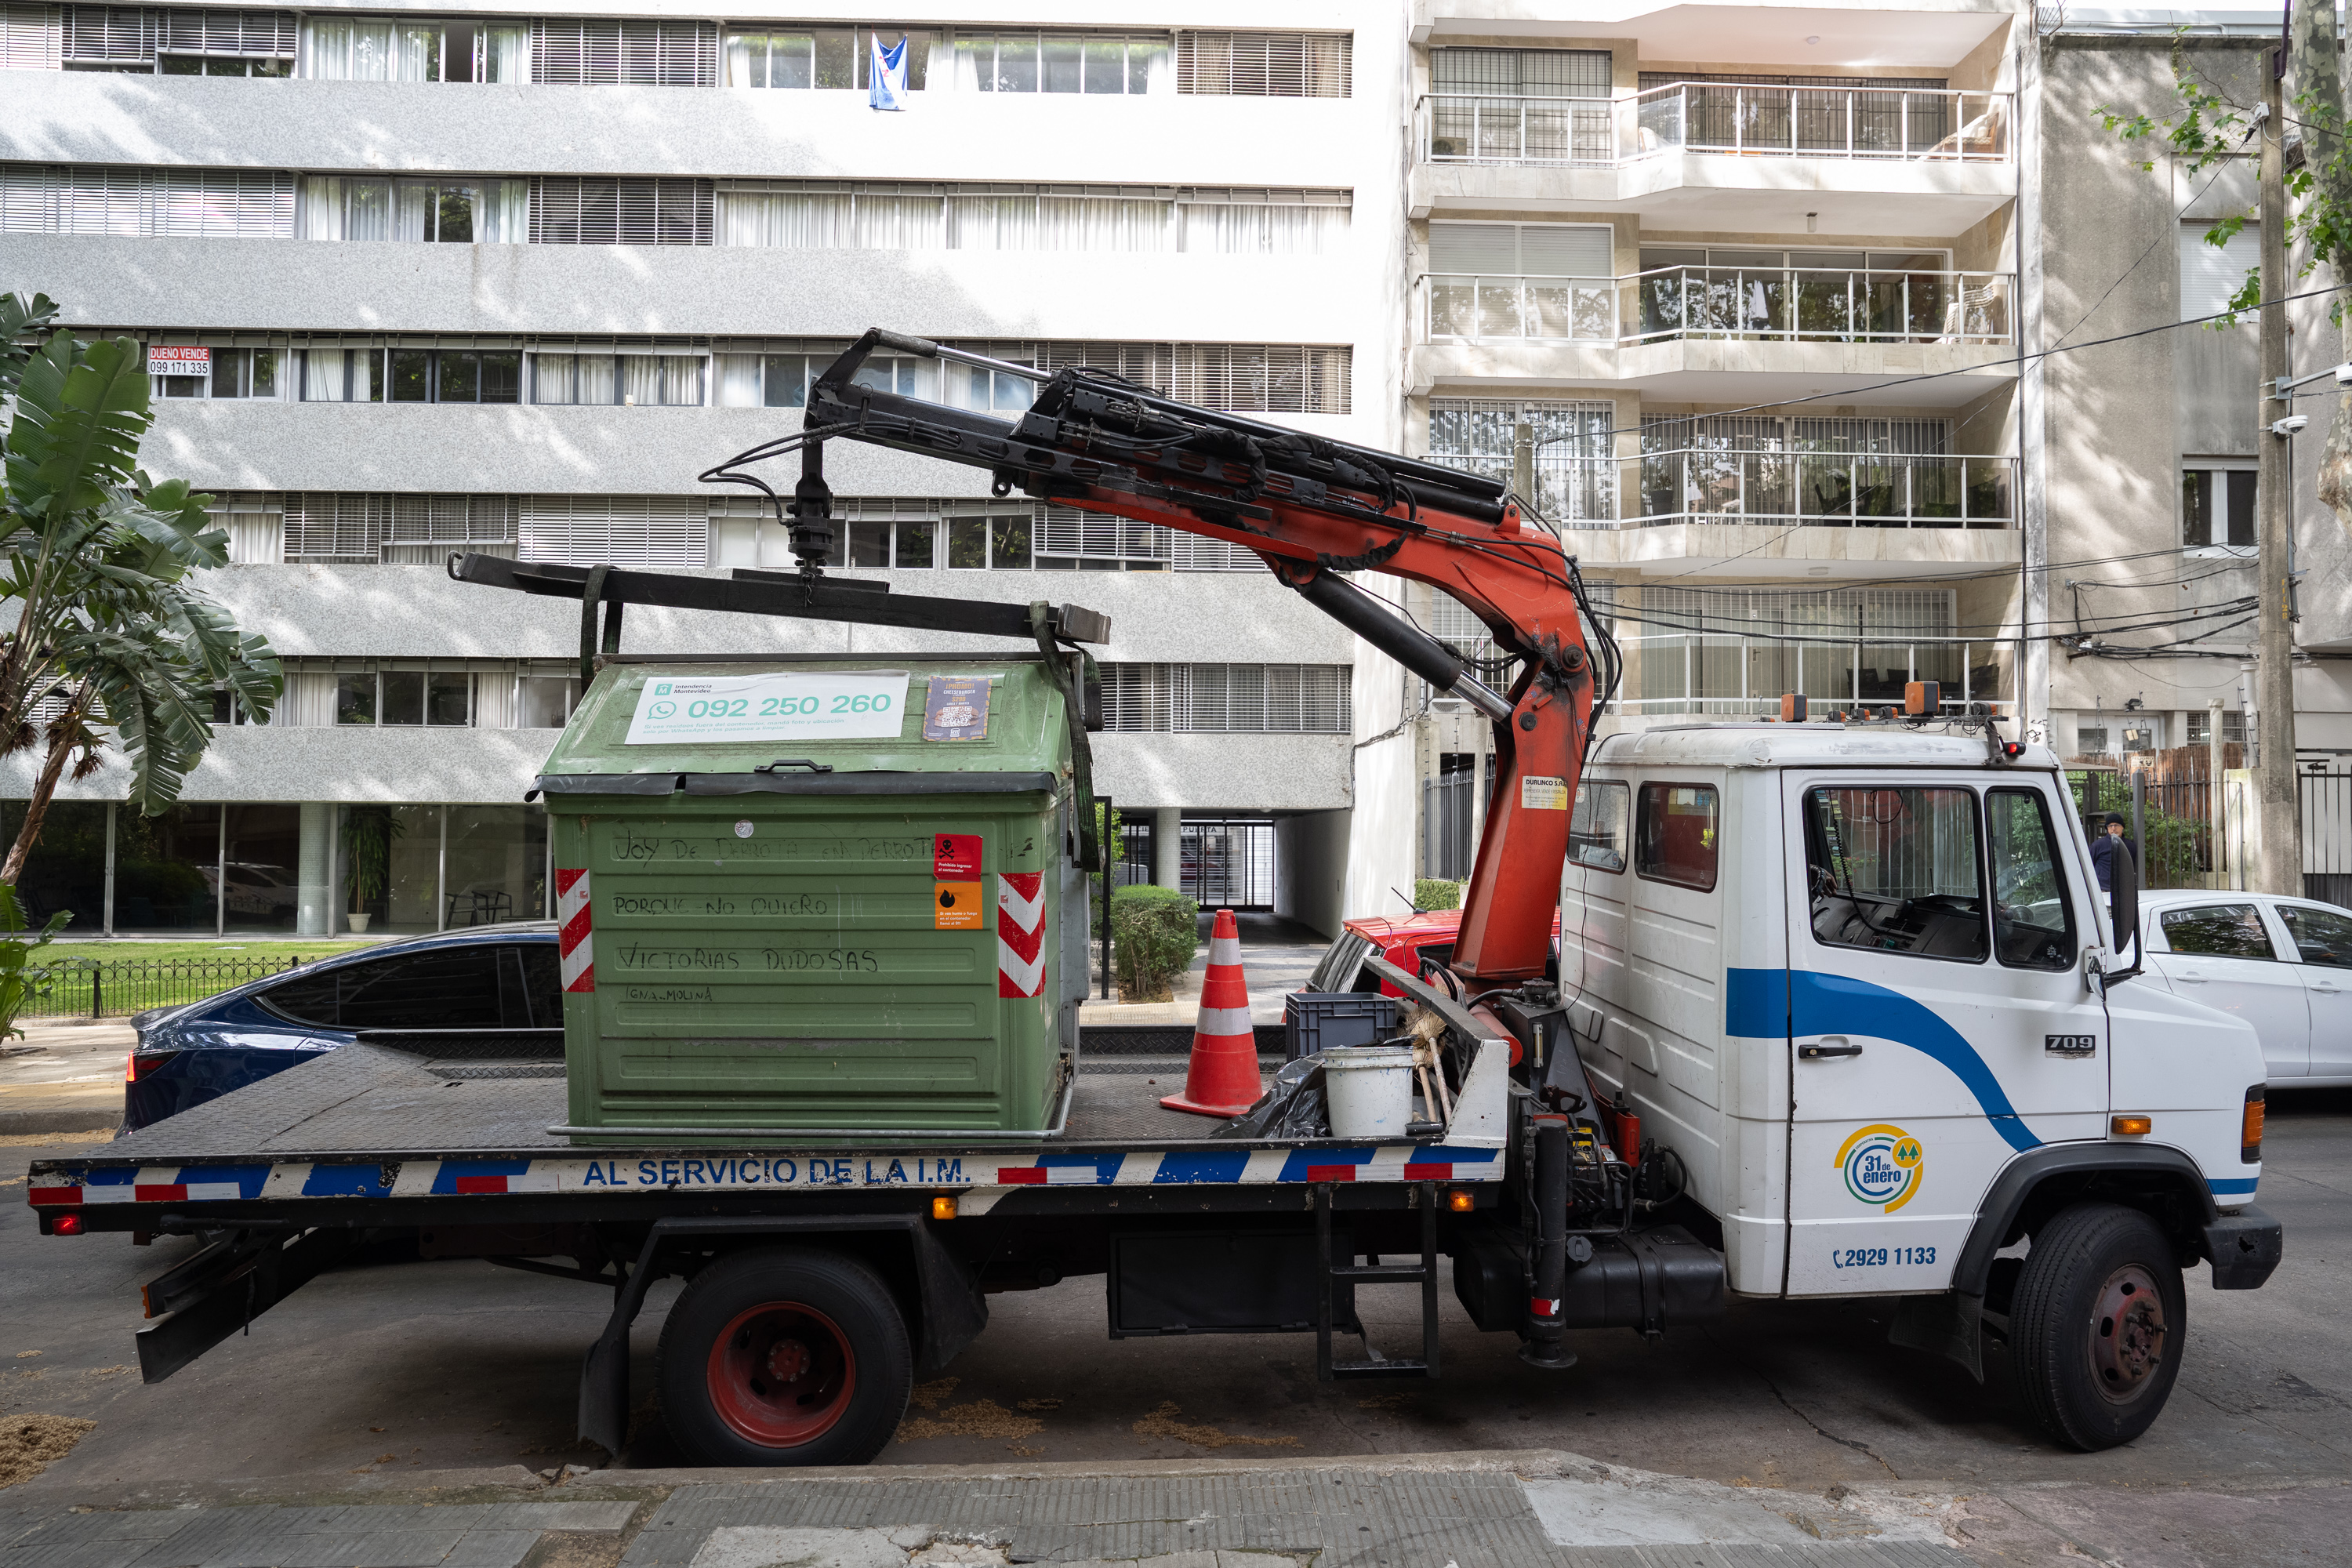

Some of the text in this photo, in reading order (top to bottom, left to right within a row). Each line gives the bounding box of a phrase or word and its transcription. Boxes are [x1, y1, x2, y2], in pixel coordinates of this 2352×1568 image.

[180, 348, 208, 359] VENDE
[151, 361, 208, 373] 099 171 335
[688, 694, 891, 718] 092 250 260
[2049, 1036, 2092, 1047] 709
[1865, 1156, 1881, 1171] 31
[583, 1159, 971, 1185] AL SERVICIO DE LA I.M.
[1863, 1171, 1901, 1183] enero
[1845, 1247, 1936, 1266] 2929 1133
